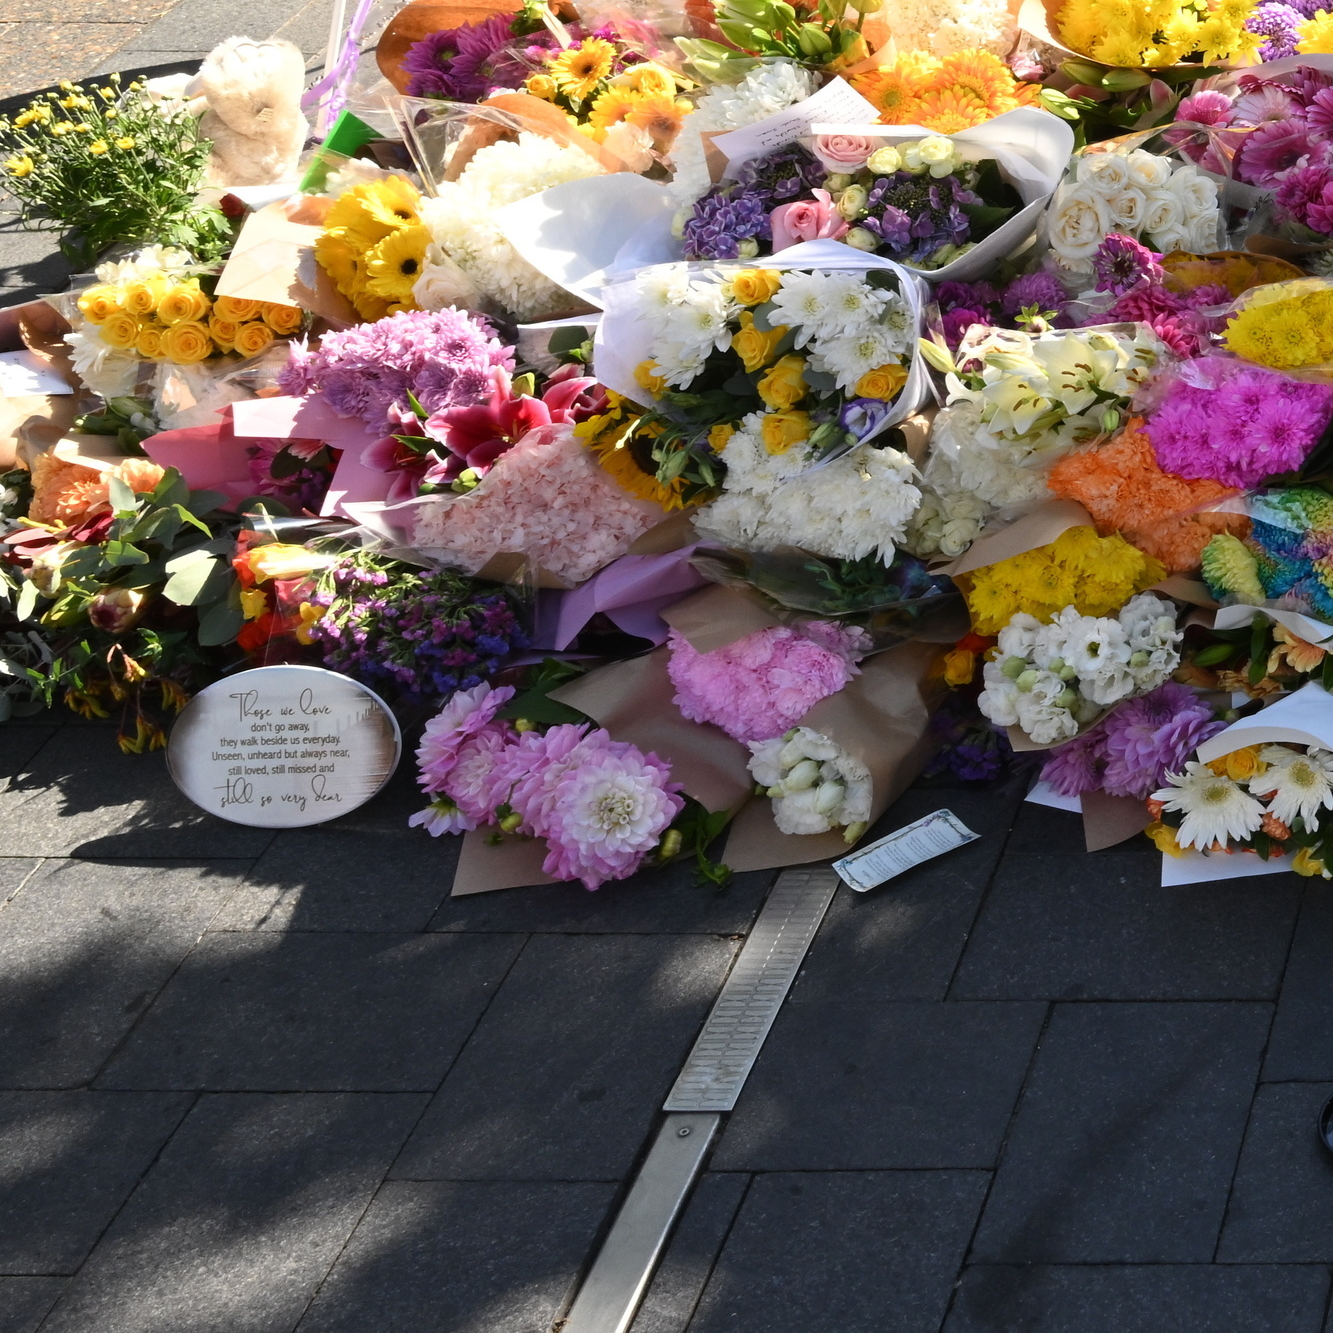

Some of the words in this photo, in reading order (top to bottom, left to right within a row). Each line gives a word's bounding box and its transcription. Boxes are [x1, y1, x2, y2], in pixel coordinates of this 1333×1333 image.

[229, 689, 272, 722] Those
[281, 706, 295, 716] we
[300, 688, 332, 716] love
[251, 721, 272, 732] don't
[275, 724, 285, 734] go
[288, 723, 309, 732] away,
[220, 737, 237, 748] they
[240, 736, 259, 746] walk
[261, 736, 288, 745] beside
[290, 737, 300, 745] us
[303, 735, 341, 747] everyday.
[212, 751, 245, 762] Unseen,
[248, 750, 282, 760] unheard
[284, 750, 298, 759] but
[300, 749, 327, 761] always
[330, 750, 350, 759] near,
[228, 765, 242, 775] still
[245, 765, 269, 776] loved,
[271, 764, 285, 774] still
[288, 763, 316, 774] missed
[319, 763, 335, 773] and
[213, 777, 253, 808] still
[260, 796, 272, 807] so
[281, 794, 306, 812] very
[311, 774, 342, 803] dear
